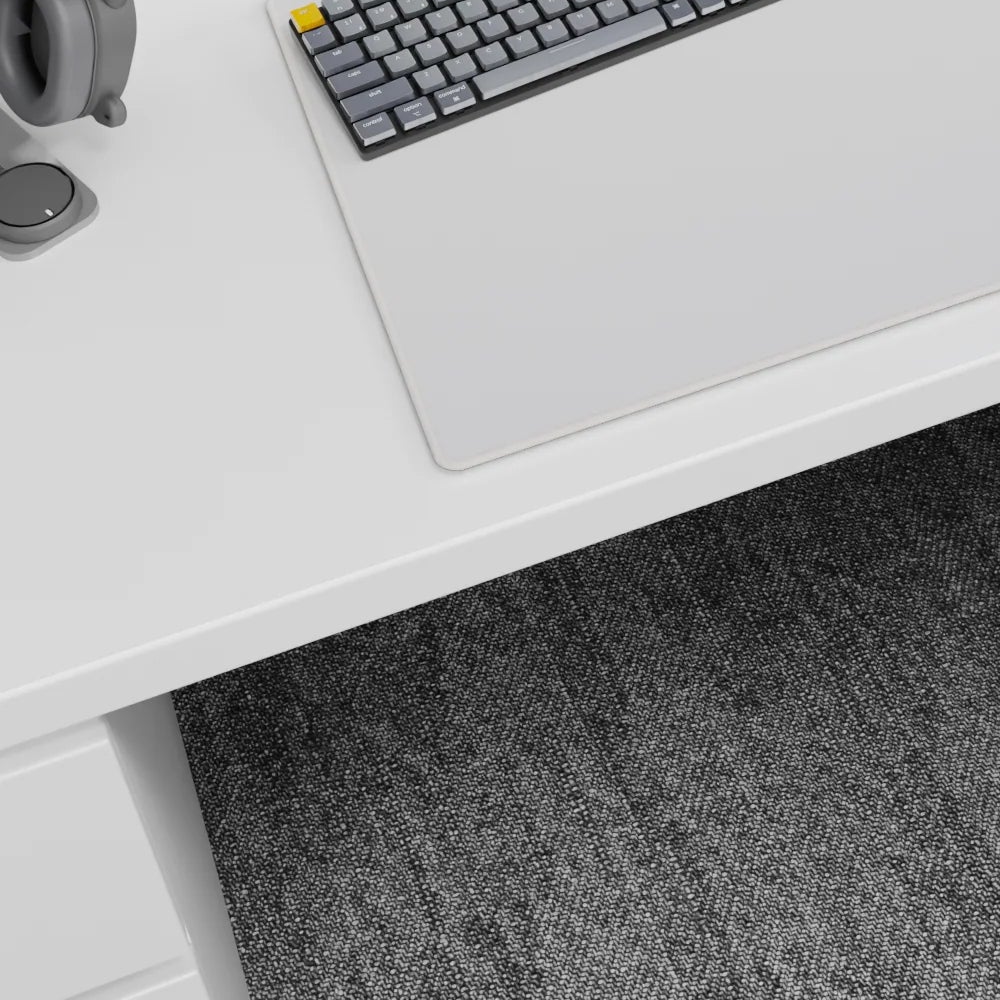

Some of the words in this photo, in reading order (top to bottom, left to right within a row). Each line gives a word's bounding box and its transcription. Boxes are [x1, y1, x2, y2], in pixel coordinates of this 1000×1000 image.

[438, 84, 466, 99] command
[403, 101, 422, 114] option
[362, 116, 383, 128] control
